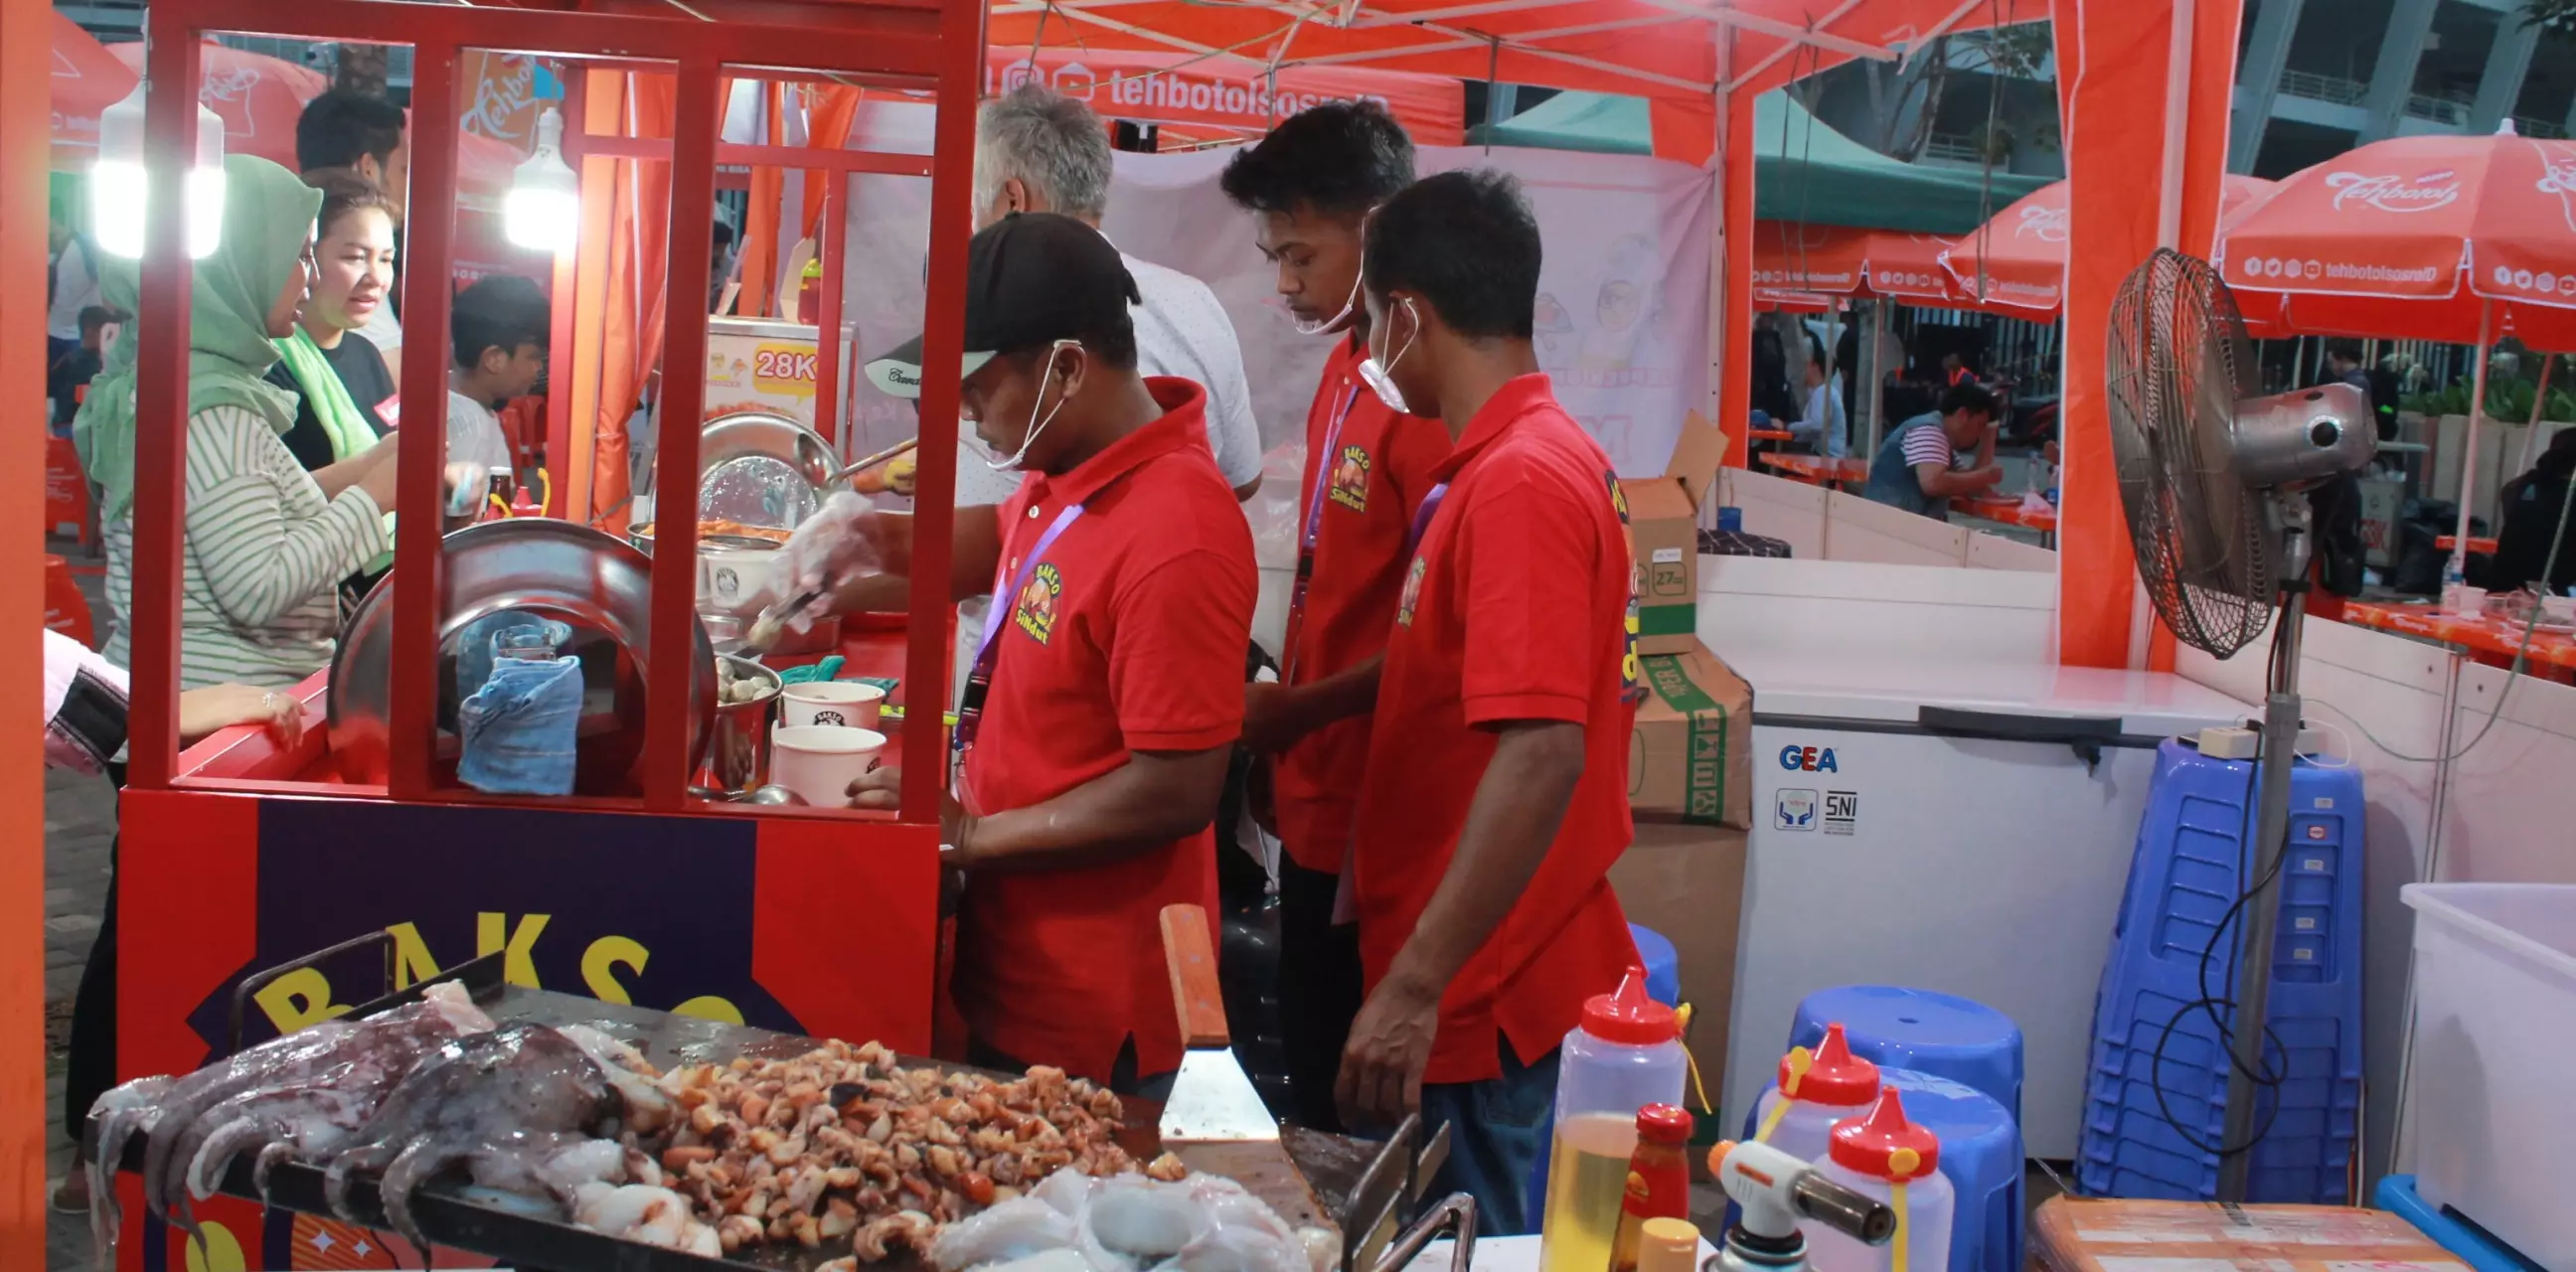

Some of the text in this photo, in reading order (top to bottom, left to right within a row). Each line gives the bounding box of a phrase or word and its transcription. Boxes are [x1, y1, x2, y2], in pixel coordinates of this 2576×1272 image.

[1108, 71, 1388, 117] tehbotolsos
[2326, 171, 2461, 212] Tehbotol
[756, 350, 817, 382] 28K
[1344, 447, 1370, 471] BAKSO
[1036, 563, 1060, 595] BAKSO
[816, 711, 844, 723] BAKSO
[1779, 744, 1838, 773] GEA
[1826, 795, 1857, 817] SNI
